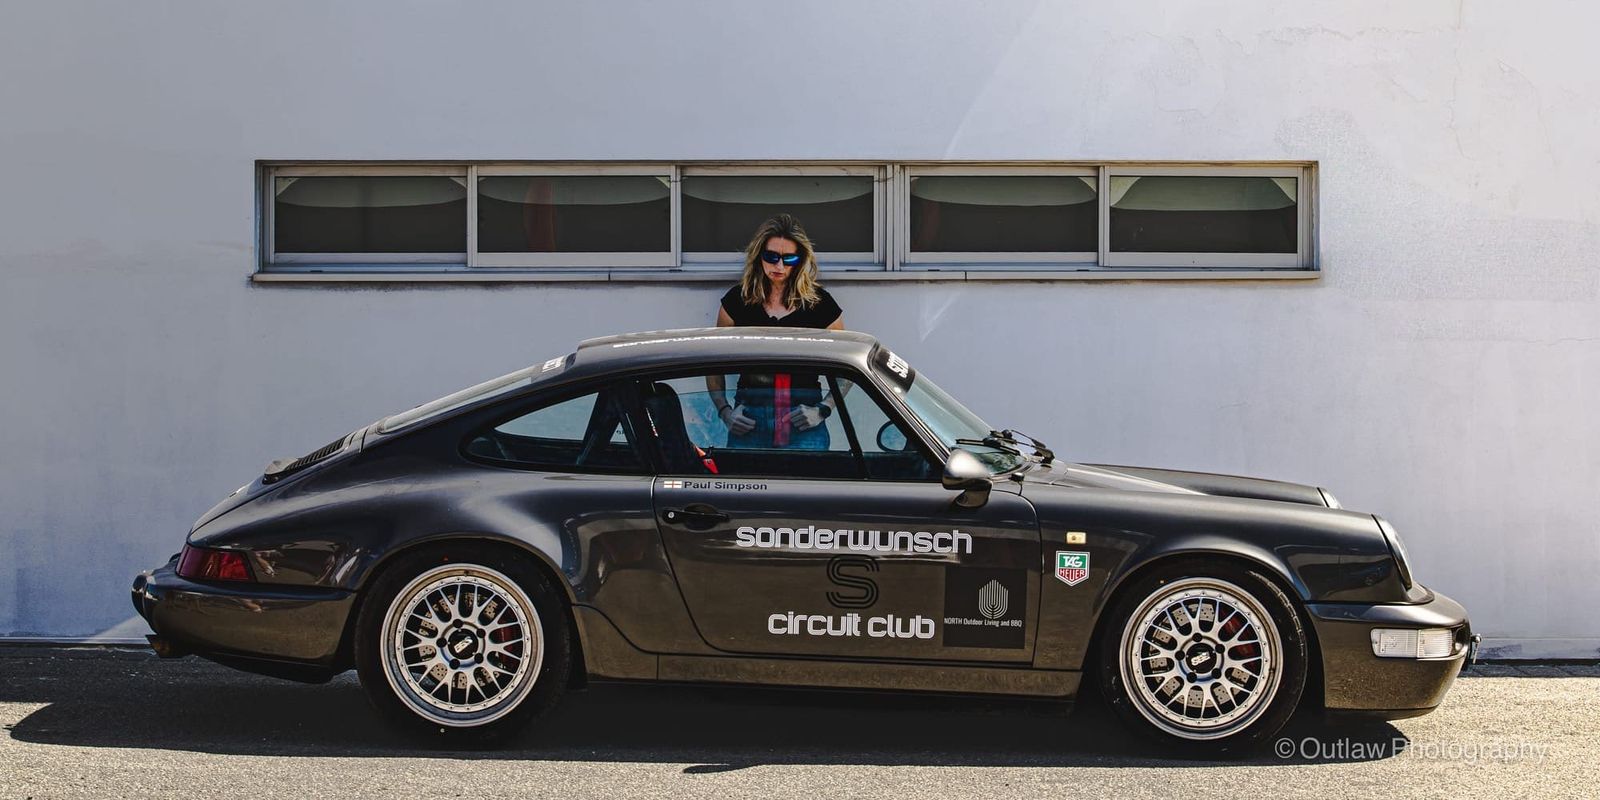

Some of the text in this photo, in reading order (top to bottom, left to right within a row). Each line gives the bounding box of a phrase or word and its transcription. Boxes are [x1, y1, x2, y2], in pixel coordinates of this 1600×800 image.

[684, 481, 768, 492] Paul Simpson
[735, 525, 973, 554] sonderwunsch
[1062, 555, 1083, 568] TAG
[1060, 569, 1085, 581] HEUER
[767, 611, 936, 639] circuit club
[944, 617, 963, 625] NORTH
[963, 618, 983, 626] Outdoor
[984, 619, 1000, 628] Living
[1010, 619, 1023, 628] BBQ
